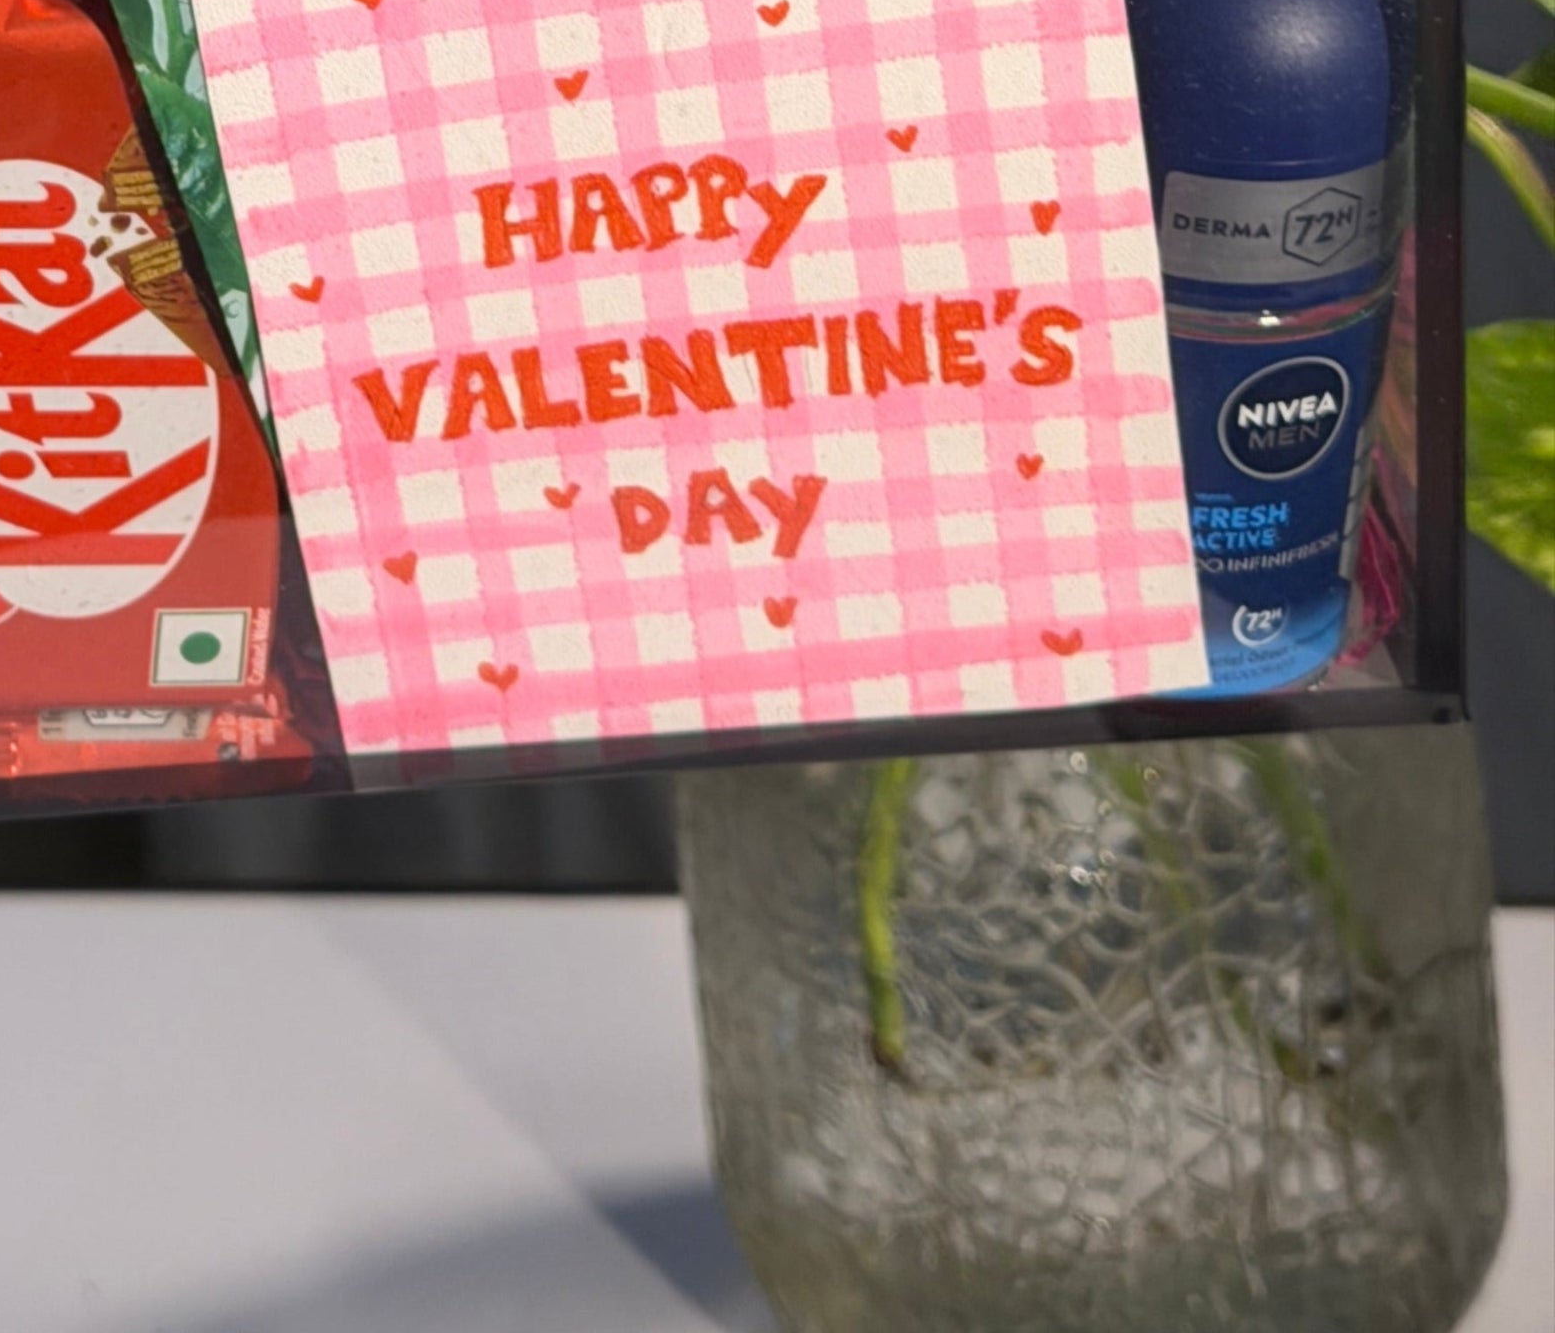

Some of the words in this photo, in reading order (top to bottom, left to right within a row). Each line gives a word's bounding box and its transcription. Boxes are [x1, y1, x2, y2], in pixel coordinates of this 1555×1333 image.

[1172, 213, 1271, 238] DERMA
[352, 288, 1082, 442] VALENTINE'S
[1237, 391, 1338, 428] NIVEA
[1248, 421, 1321, 450] MEN
[610, 468, 827, 559] DAY
[1193, 501, 1289, 529] FRESH
